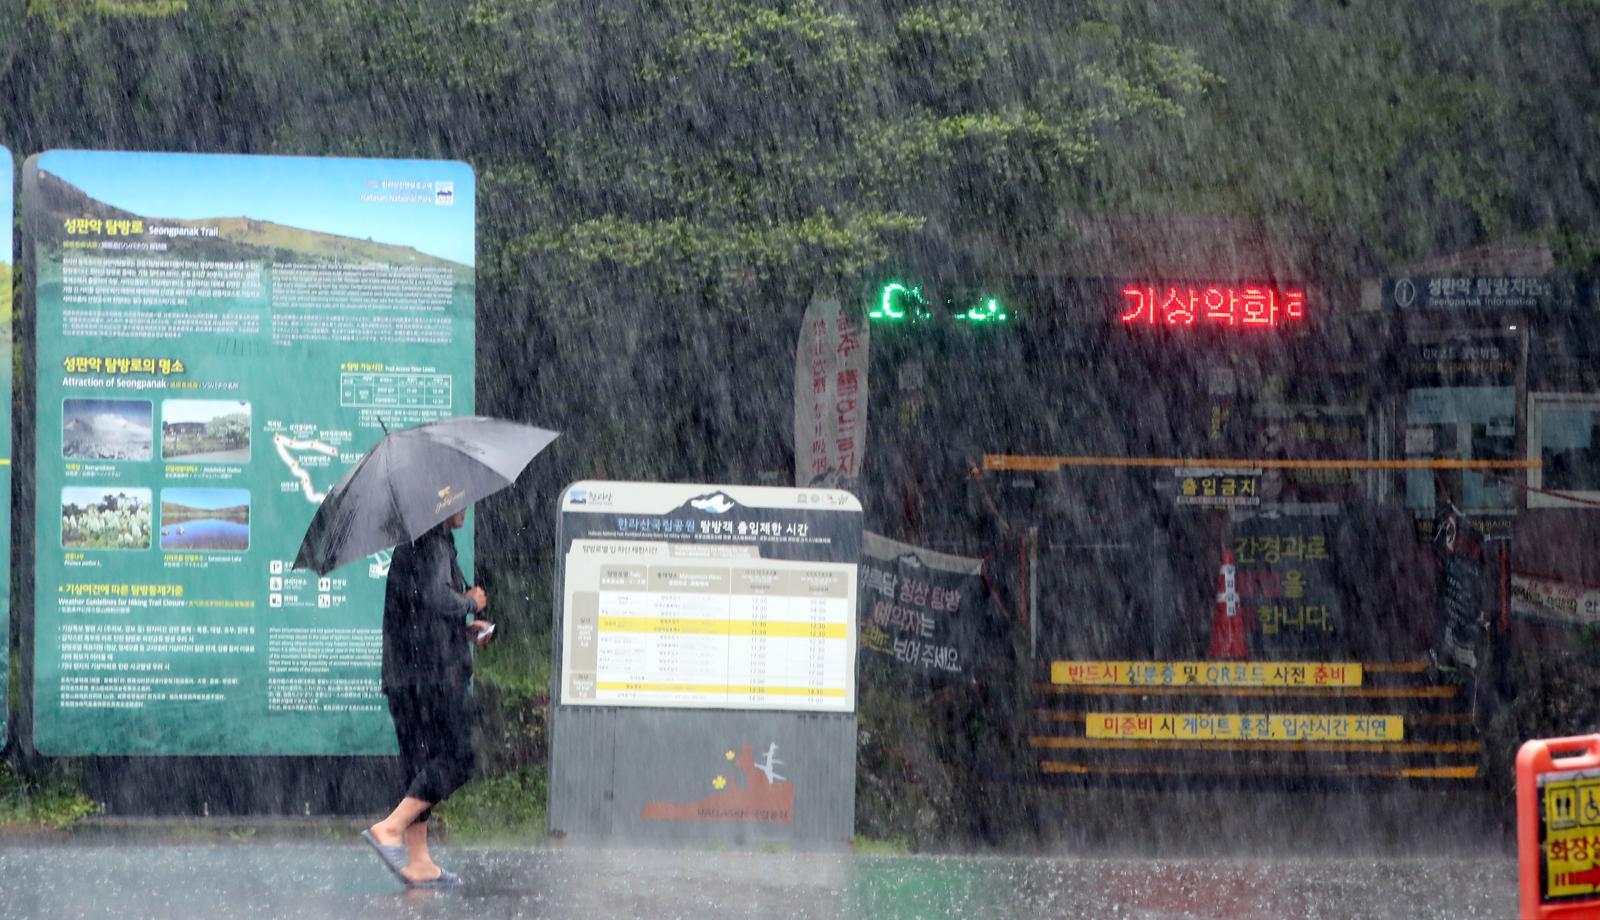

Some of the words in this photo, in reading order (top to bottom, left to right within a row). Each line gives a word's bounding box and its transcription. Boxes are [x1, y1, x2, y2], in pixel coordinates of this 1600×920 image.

[65, 218, 103, 236] 성판악
[105, 218, 145, 236] 탐방로
[148, 223, 199, 238] Seongpanak
[200, 226, 220, 237] Trail
[64, 356, 102, 374] 성판악
[105, 357, 156, 375] 탐방로의
[158, 358, 186, 376] 명소
[63, 377, 104, 387] Attraction
[106, 377, 115, 387] of
[117, 378, 167, 392] Seongpanak
[1182, 477, 1256, 497] 출입금지
[617, 517, 696, 533] 한라산국립공원
[700, 519, 734, 535] 탐방객
[737, 520, 783, 537] 출입제한
[786, 522, 809, 538] 시간
[58, 598, 85, 607] Weather
[85, 598, 118, 607] Guidelines
[118, 599, 128, 607] for
[129, 599, 148, 609] Hiking
[149, 599, 162, 607] Trail
[162, 600, 185, 608] Closure
[901, 577, 930, 606] 정상
[931, 585, 961, 612] 탐방
[874, 600, 936, 638] 예약자는
[894, 637, 921, 665] 보여
[921, 643, 962, 672] 주세요
[1069, 665, 1118, 684] 반드시
[1125, 665, 1176, 686] 신분증
[1183, 666, 1198, 686] 및
[1206, 666, 1265, 685] QR코드
[1273, 666, 1306, 686] 사전
[1312, 666, 1345, 685] 준비
[1103, 717, 1153, 735] 미준비
[1159, 717, 1175, 735] 시
[1182, 716, 1233, 736] 게이트
[1239, 717, 1275, 738] 혼잡,
[1281, 718, 1349, 738] 입산시간
[1355, 718, 1387, 737] 지연
